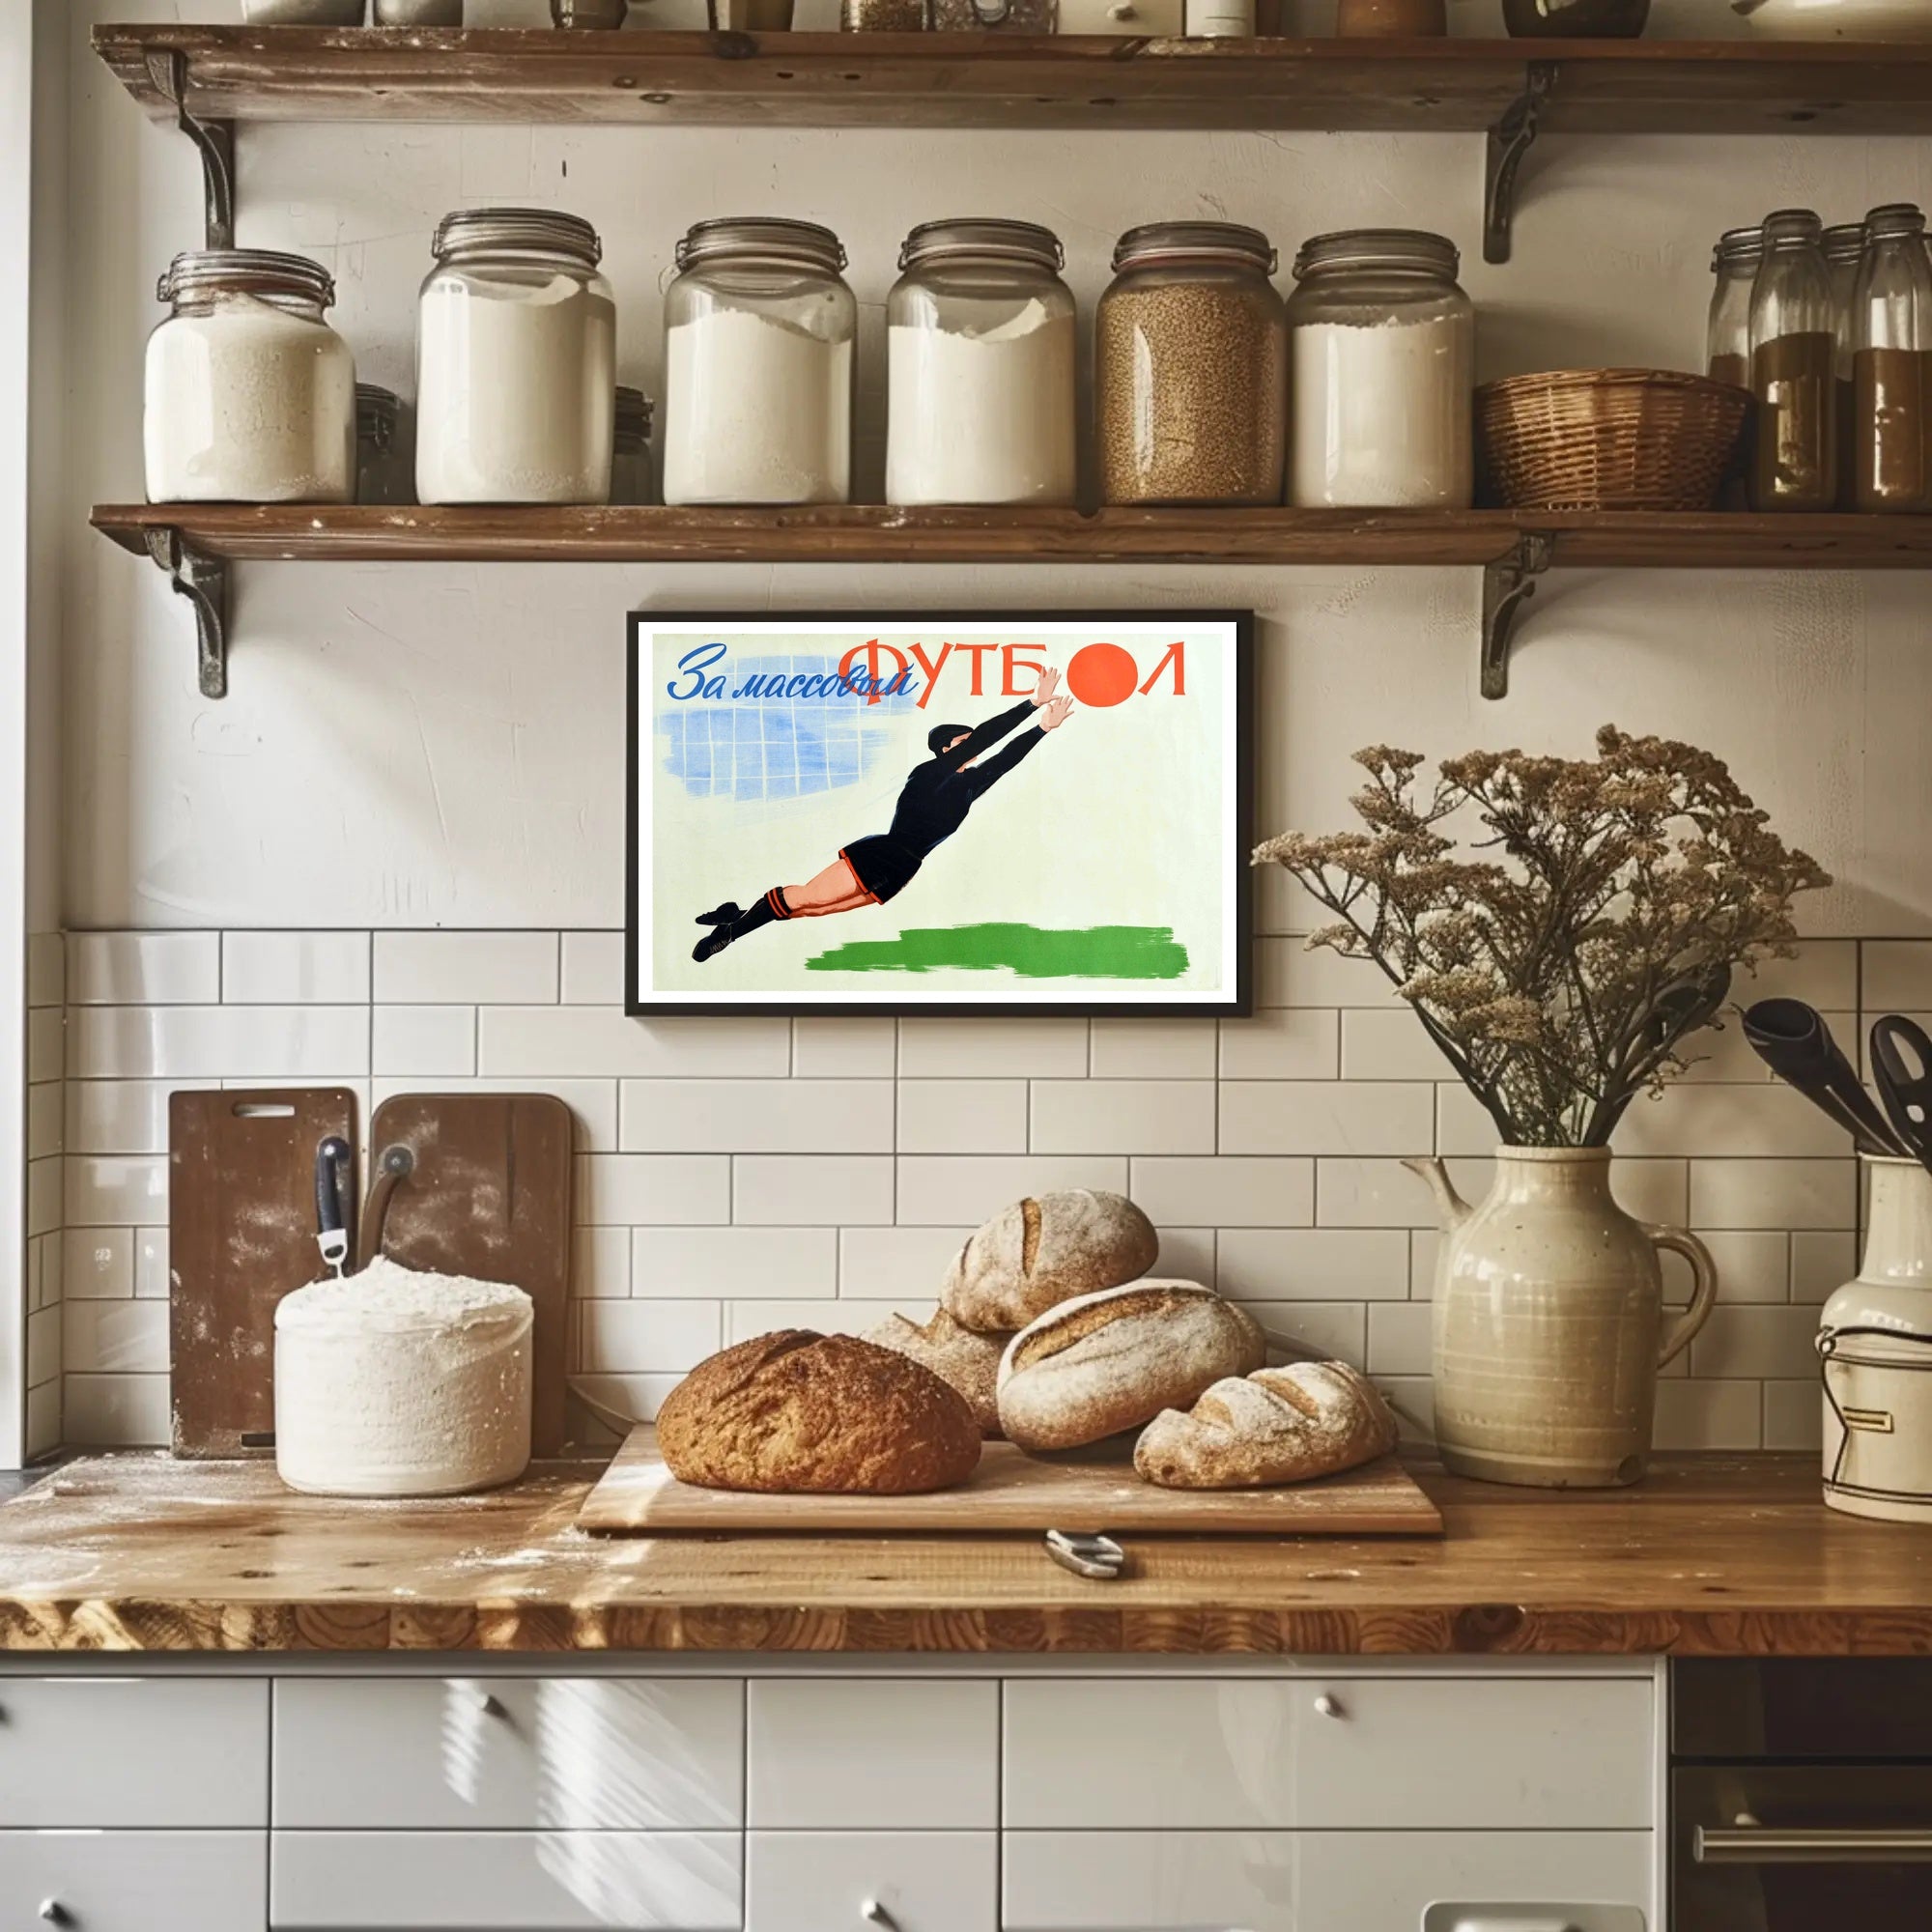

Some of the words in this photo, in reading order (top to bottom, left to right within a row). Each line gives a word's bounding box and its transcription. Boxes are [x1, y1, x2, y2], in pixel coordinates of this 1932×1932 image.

[667, 642, 727, 700] За
[731, 663, 920, 699] массовый
[838, 638, 1185, 709] ФУТБОЛ
